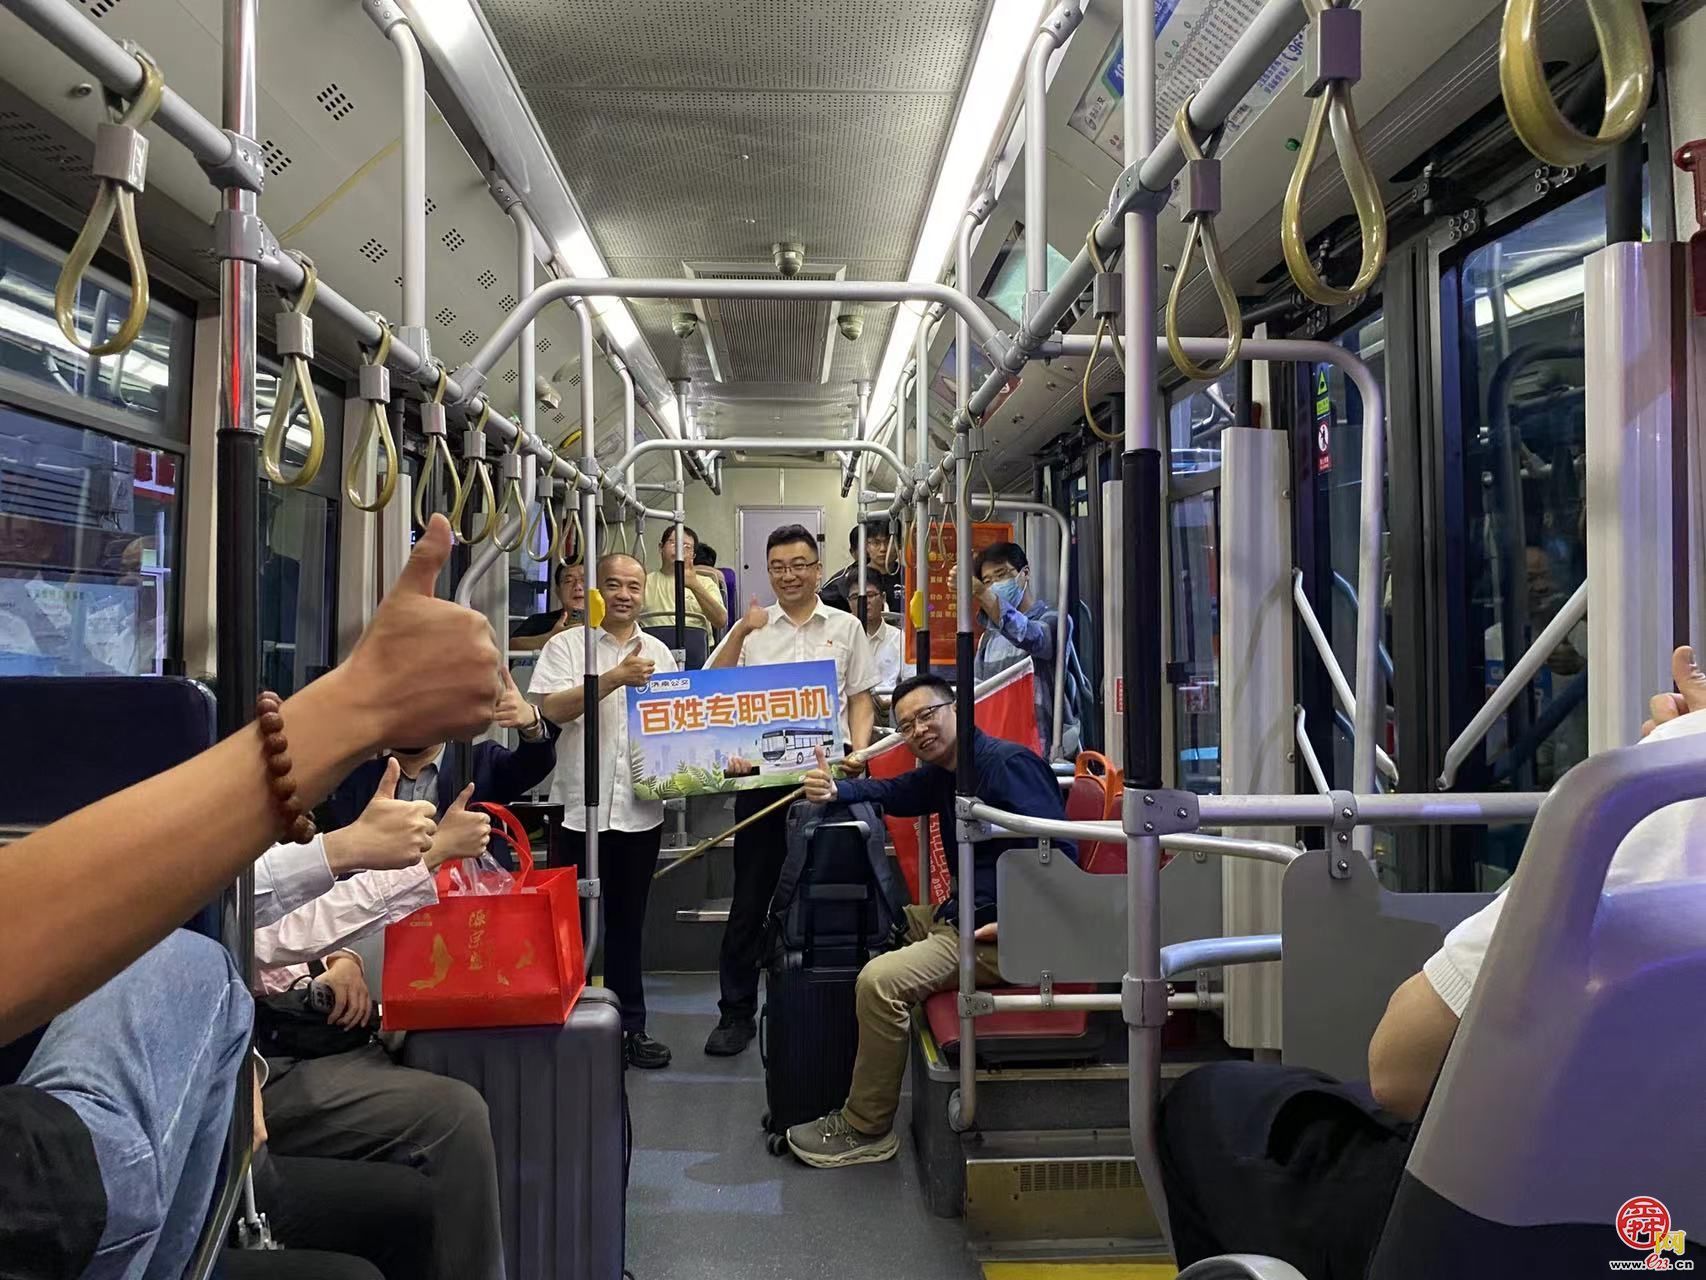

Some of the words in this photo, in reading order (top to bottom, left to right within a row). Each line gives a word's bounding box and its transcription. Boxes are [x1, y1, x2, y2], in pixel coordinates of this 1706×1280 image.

[638, 686, 831, 734] 百姓专职司机
